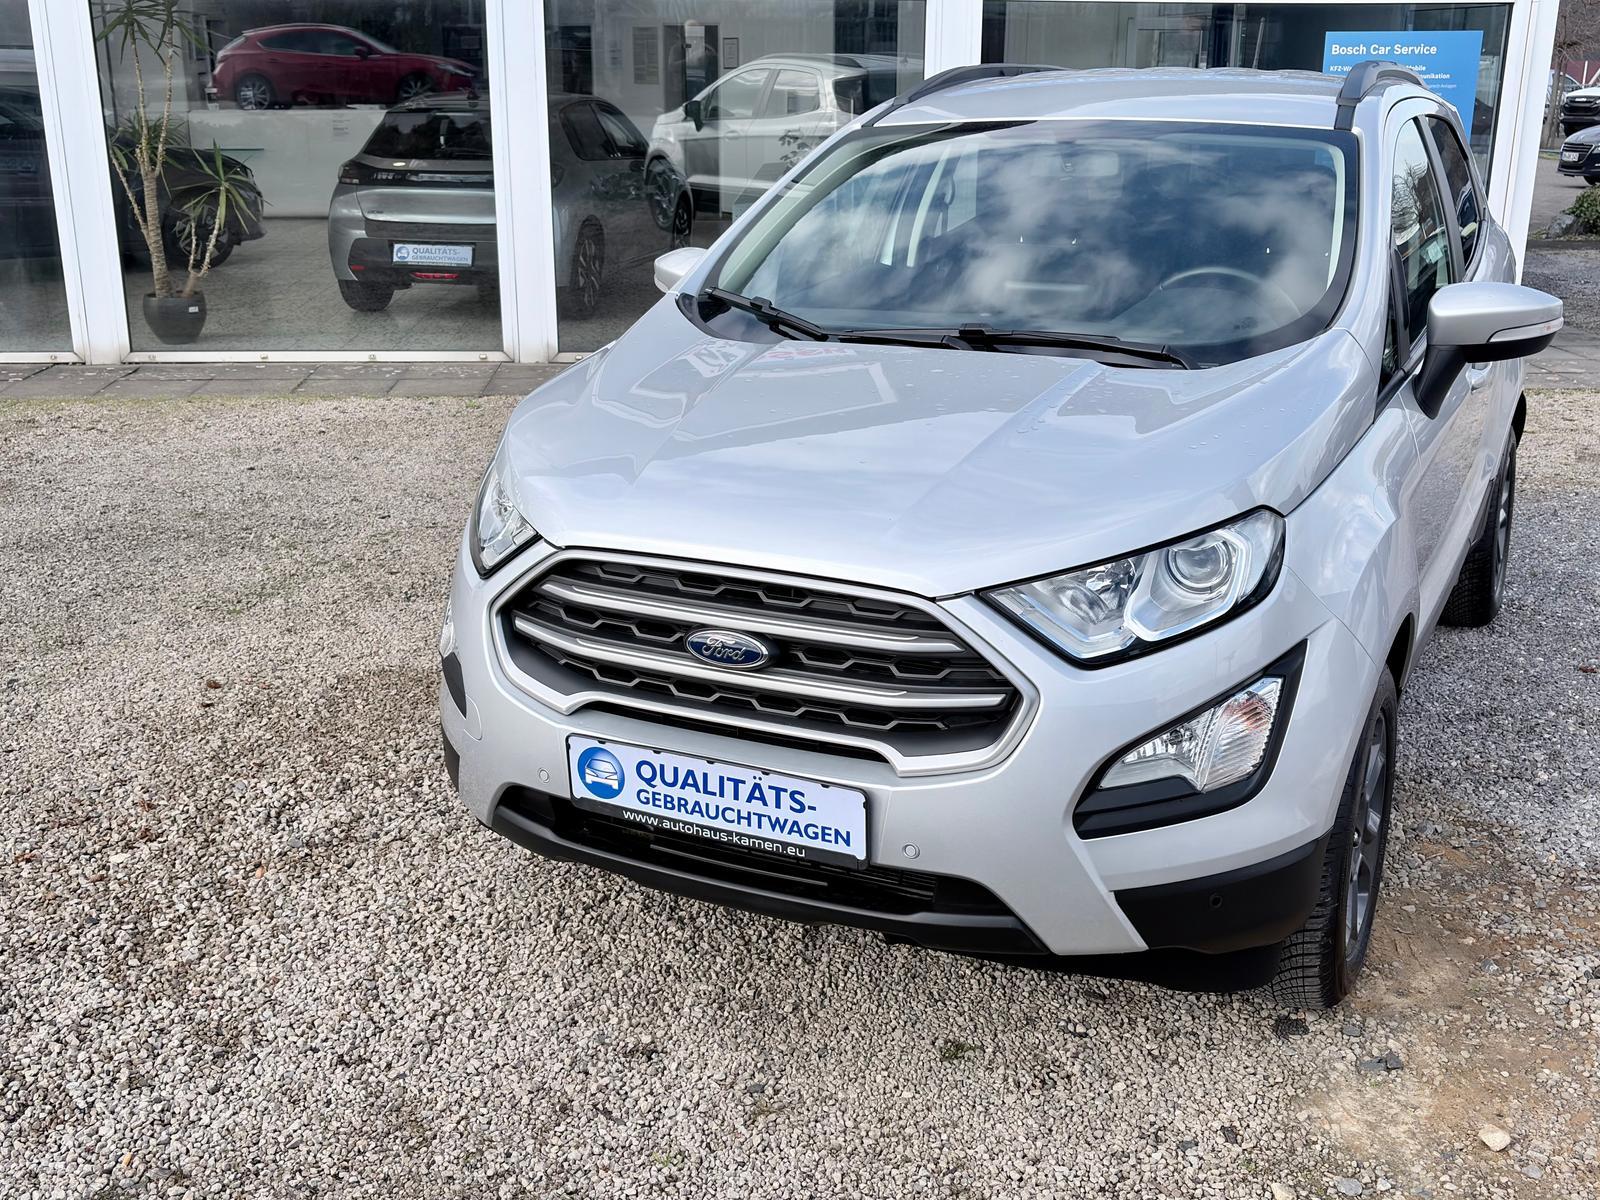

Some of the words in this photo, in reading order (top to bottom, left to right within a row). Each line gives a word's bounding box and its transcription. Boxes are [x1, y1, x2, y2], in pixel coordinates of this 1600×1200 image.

[1331, 44, 1367, 55] Bosch
[1370, 44, 1390, 55] Car
[1393, 44, 1437, 55] Service
[702, 636, 746, 661] Ford
[635, 759, 817, 814] QUALITÄTS-
[622, 809, 806, 858] www.autohaus-kamen.eu
[636, 788, 851, 848] GEBRAUCHTWAGEN
